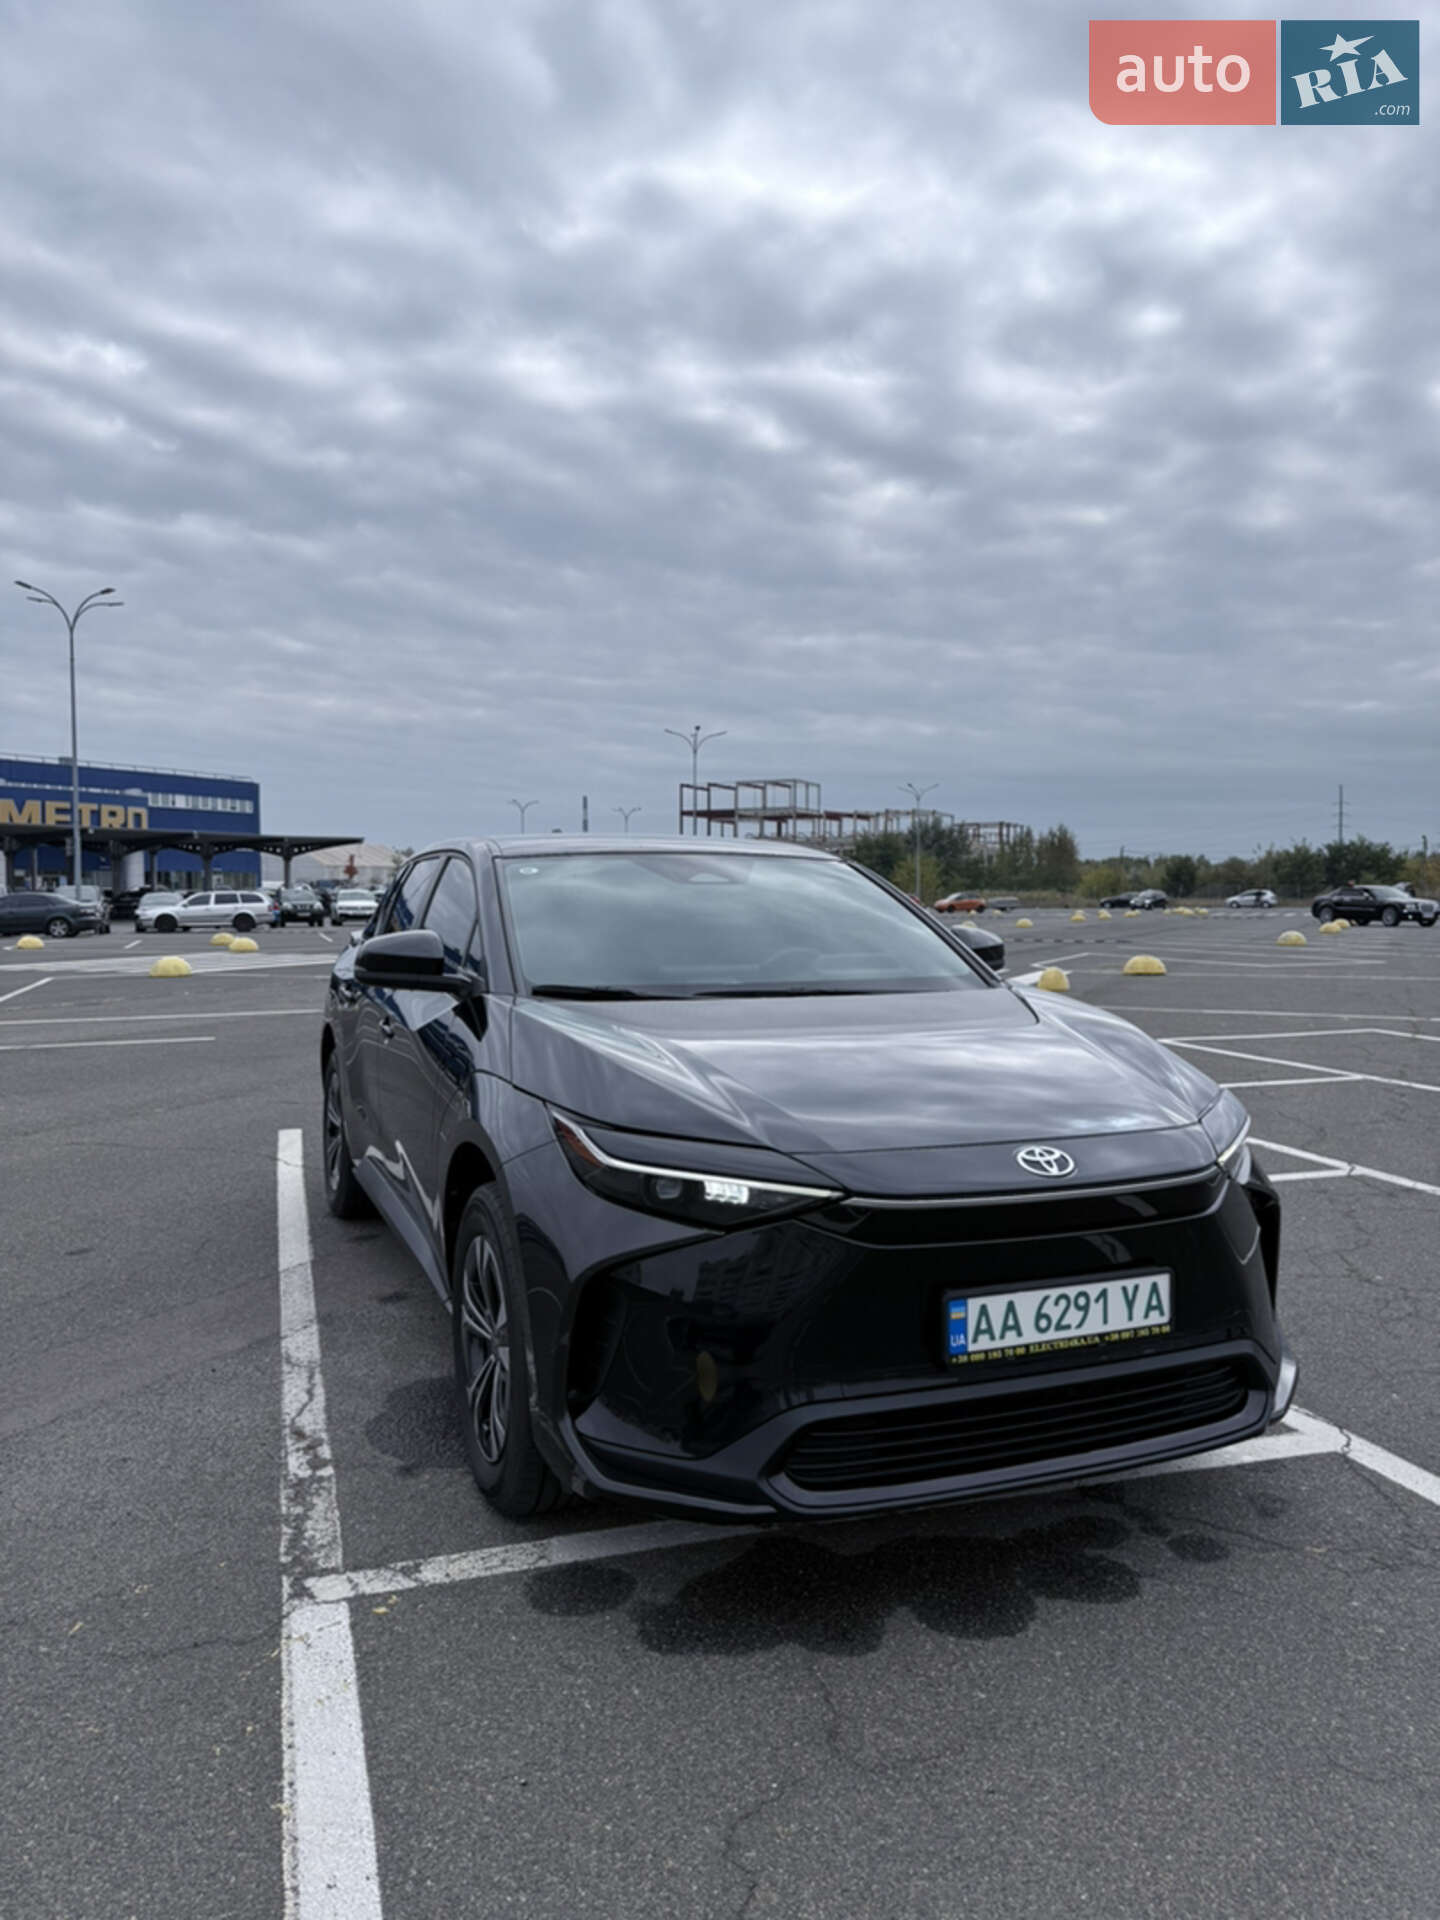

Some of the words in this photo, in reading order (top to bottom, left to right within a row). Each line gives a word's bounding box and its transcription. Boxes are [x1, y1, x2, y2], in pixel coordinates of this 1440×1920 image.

[971, 1299, 1023, 1344] AA
[1034, 1287, 1108, 1334] 6291
[1121, 1281, 1165, 1322] YA
[950, 1333, 966, 1348] UA
